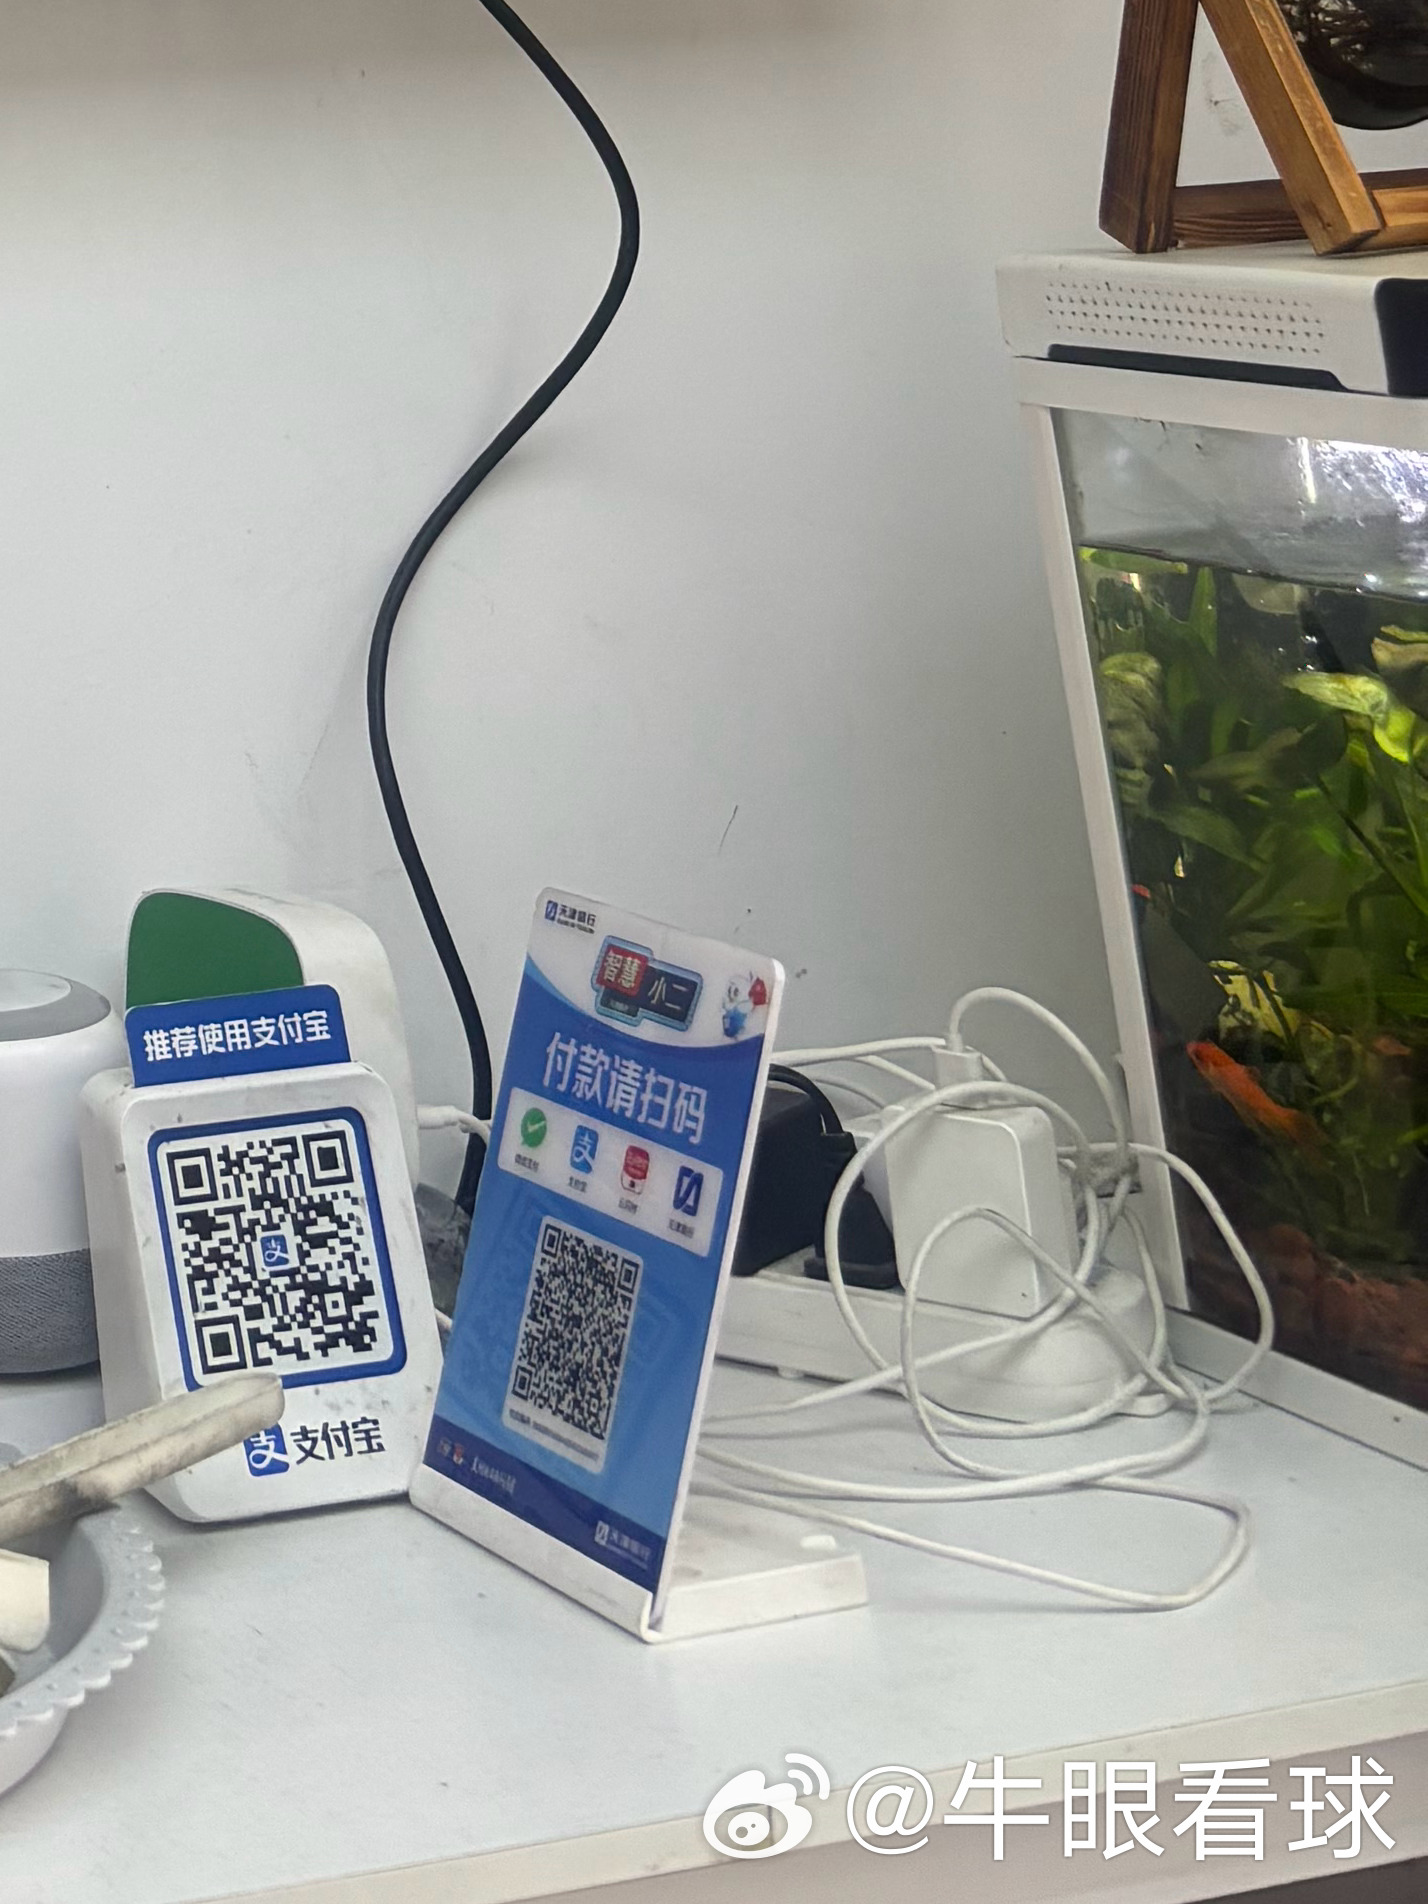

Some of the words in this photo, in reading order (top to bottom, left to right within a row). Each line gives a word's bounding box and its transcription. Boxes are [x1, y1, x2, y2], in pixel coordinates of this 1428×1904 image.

[603, 950, 643, 989] 智慧
[649, 977, 690, 1010] 小二
[144, 1010, 330, 1062] 推荐使用支付宝
[543, 1032, 708, 1145] 付款请扫码
[291, 1416, 386, 1464] 支付宝
